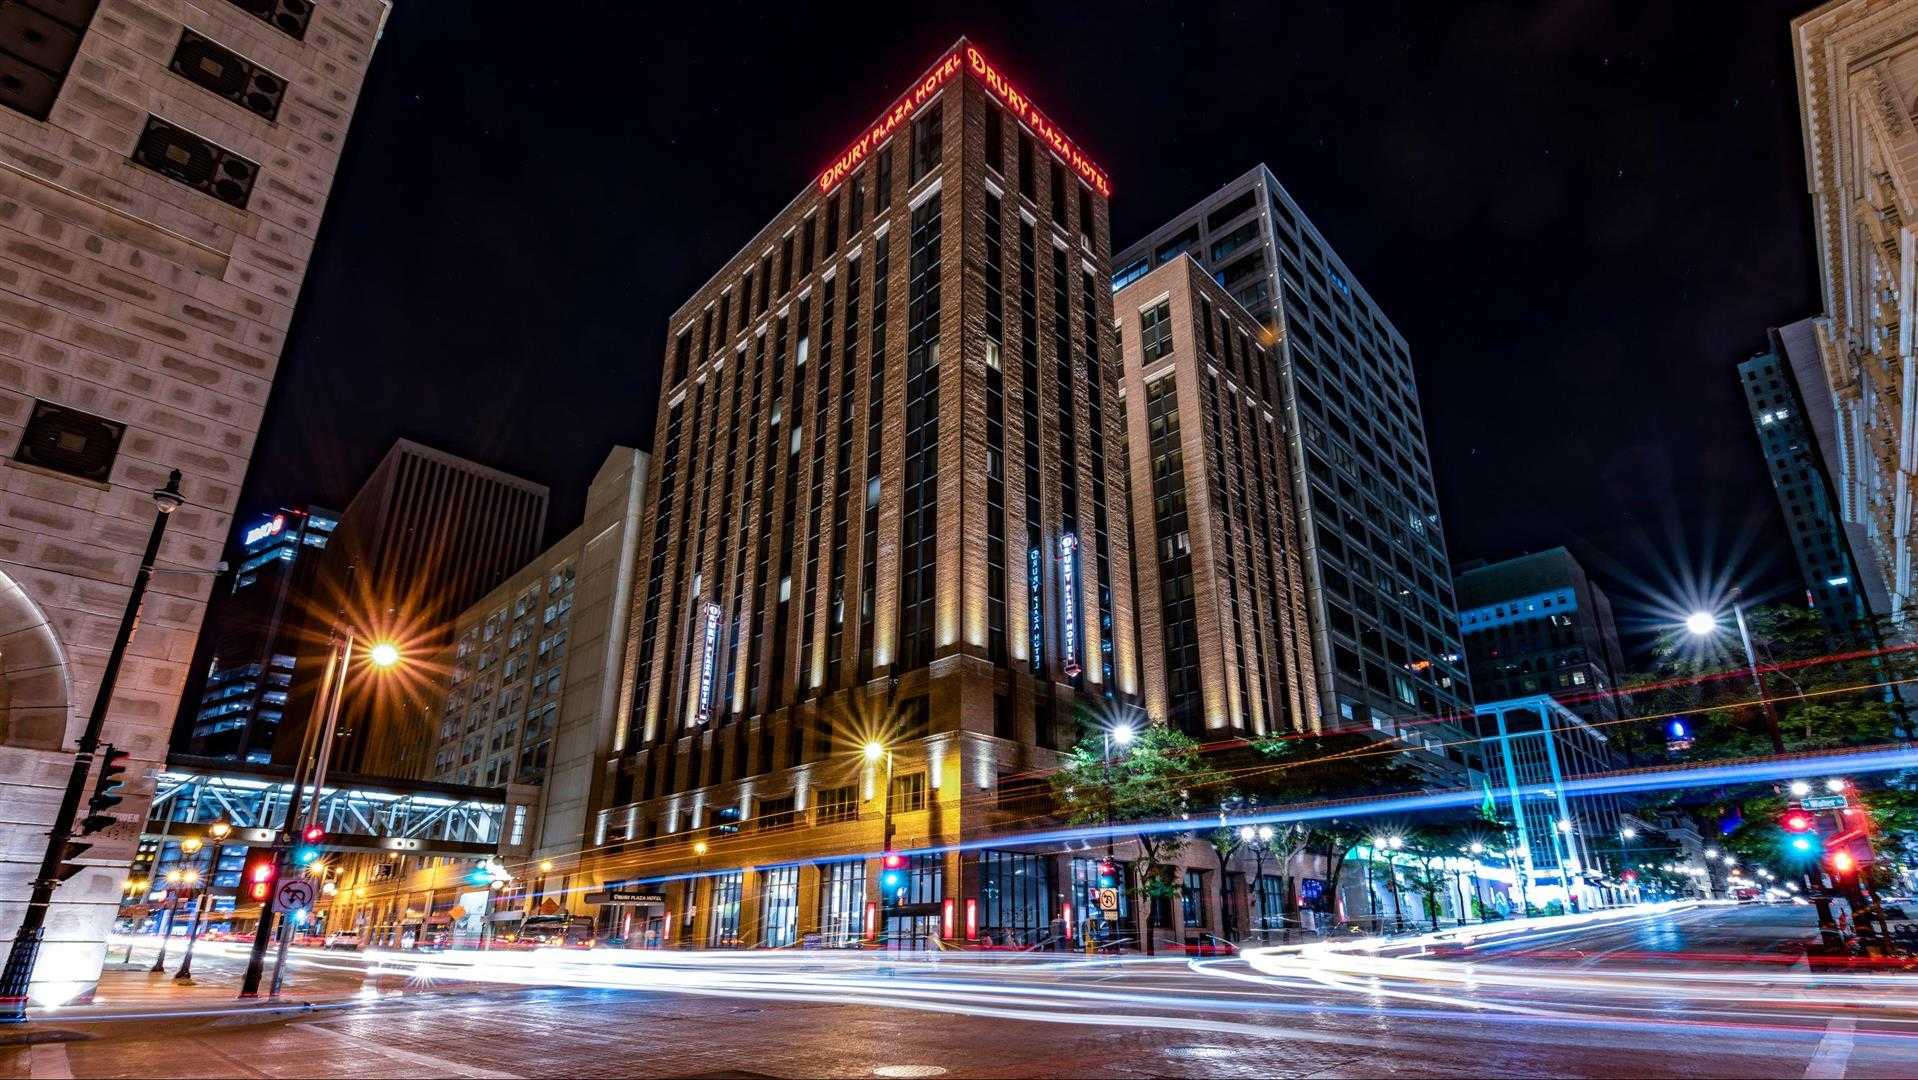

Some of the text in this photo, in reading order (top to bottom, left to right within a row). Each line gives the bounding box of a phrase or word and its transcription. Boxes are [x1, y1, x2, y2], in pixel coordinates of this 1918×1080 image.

[819, 54, 961, 192] DRURY PLAZA HOTEL
[968, 48, 1110, 197] DRURY PLAZA HOTEL
[1062, 537, 1072, 581] DRURY
[1065, 585, 1073, 620] PLAZA
